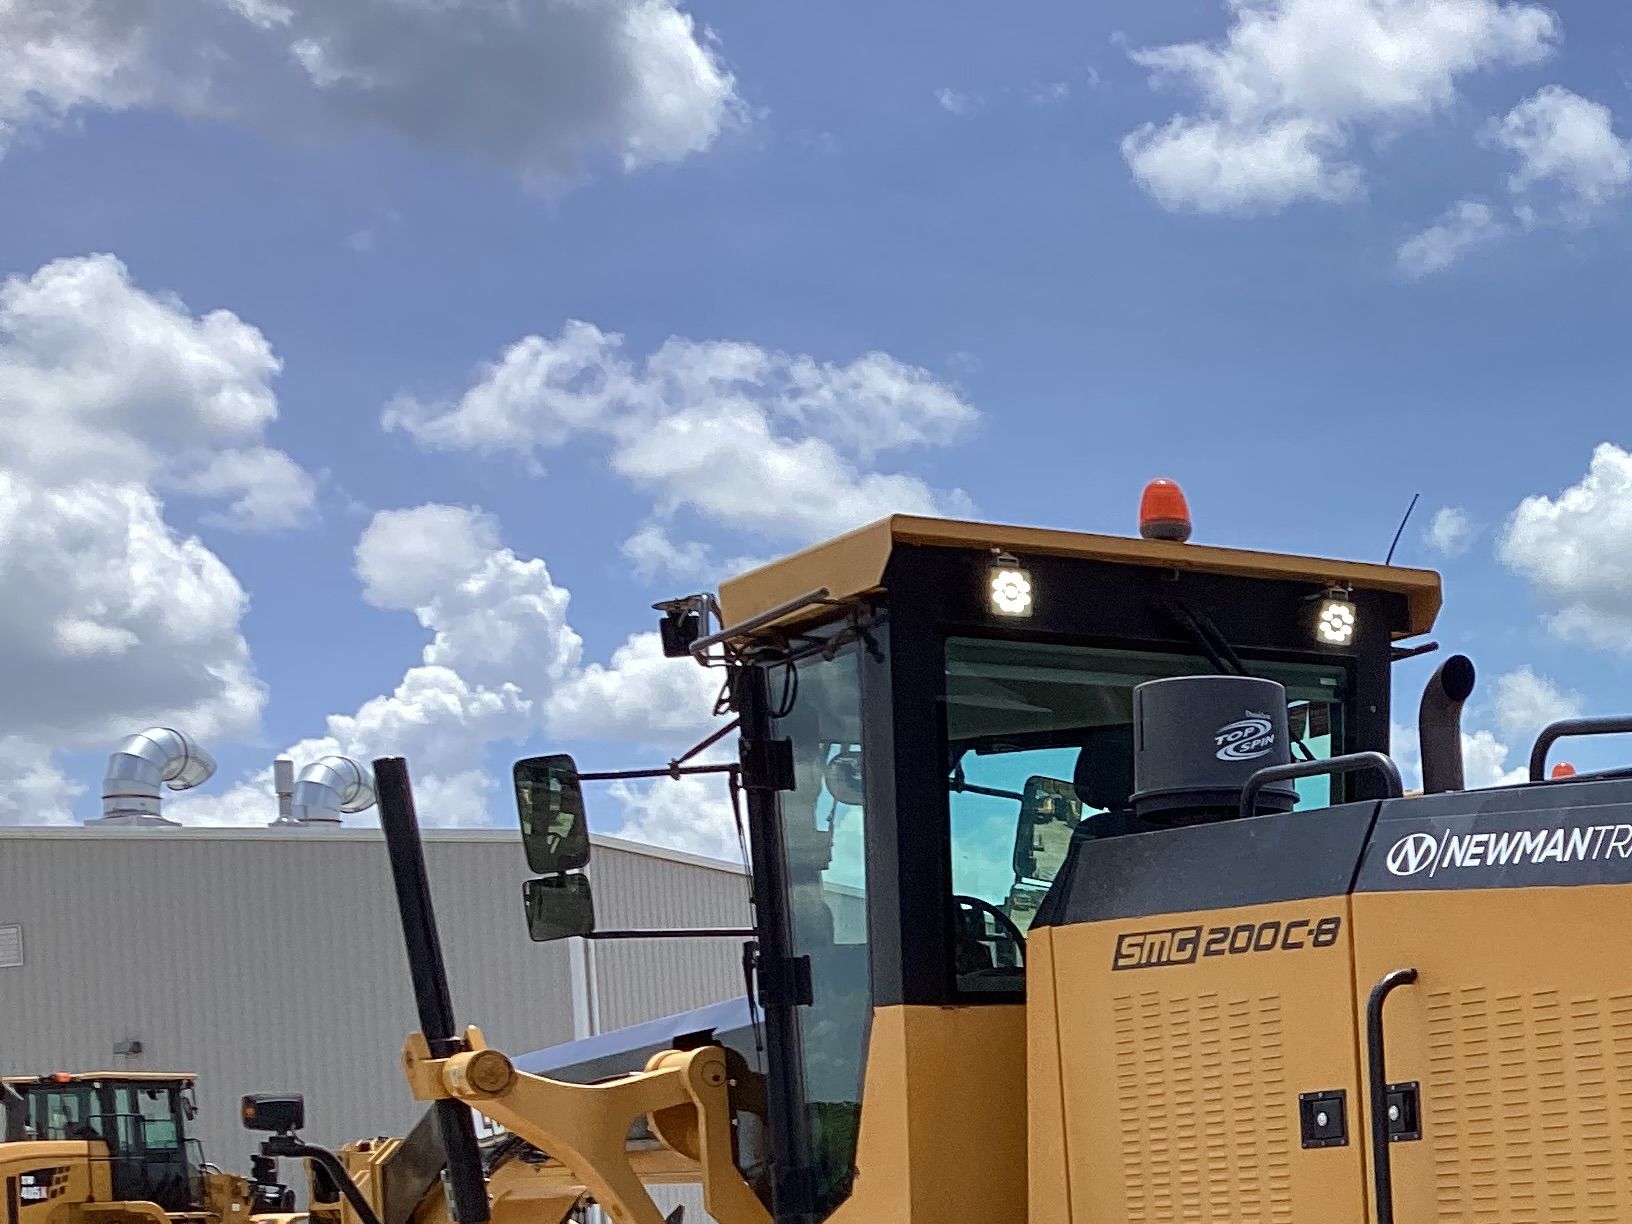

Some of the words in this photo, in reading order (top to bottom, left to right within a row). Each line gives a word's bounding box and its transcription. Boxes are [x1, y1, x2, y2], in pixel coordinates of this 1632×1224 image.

[1215, 727, 1255, 746] TOP
[1239, 734, 1275, 753] SPIN
[1116, 928, 1199, 968] SMG
[1202, 916, 1341, 957] 200C-8
